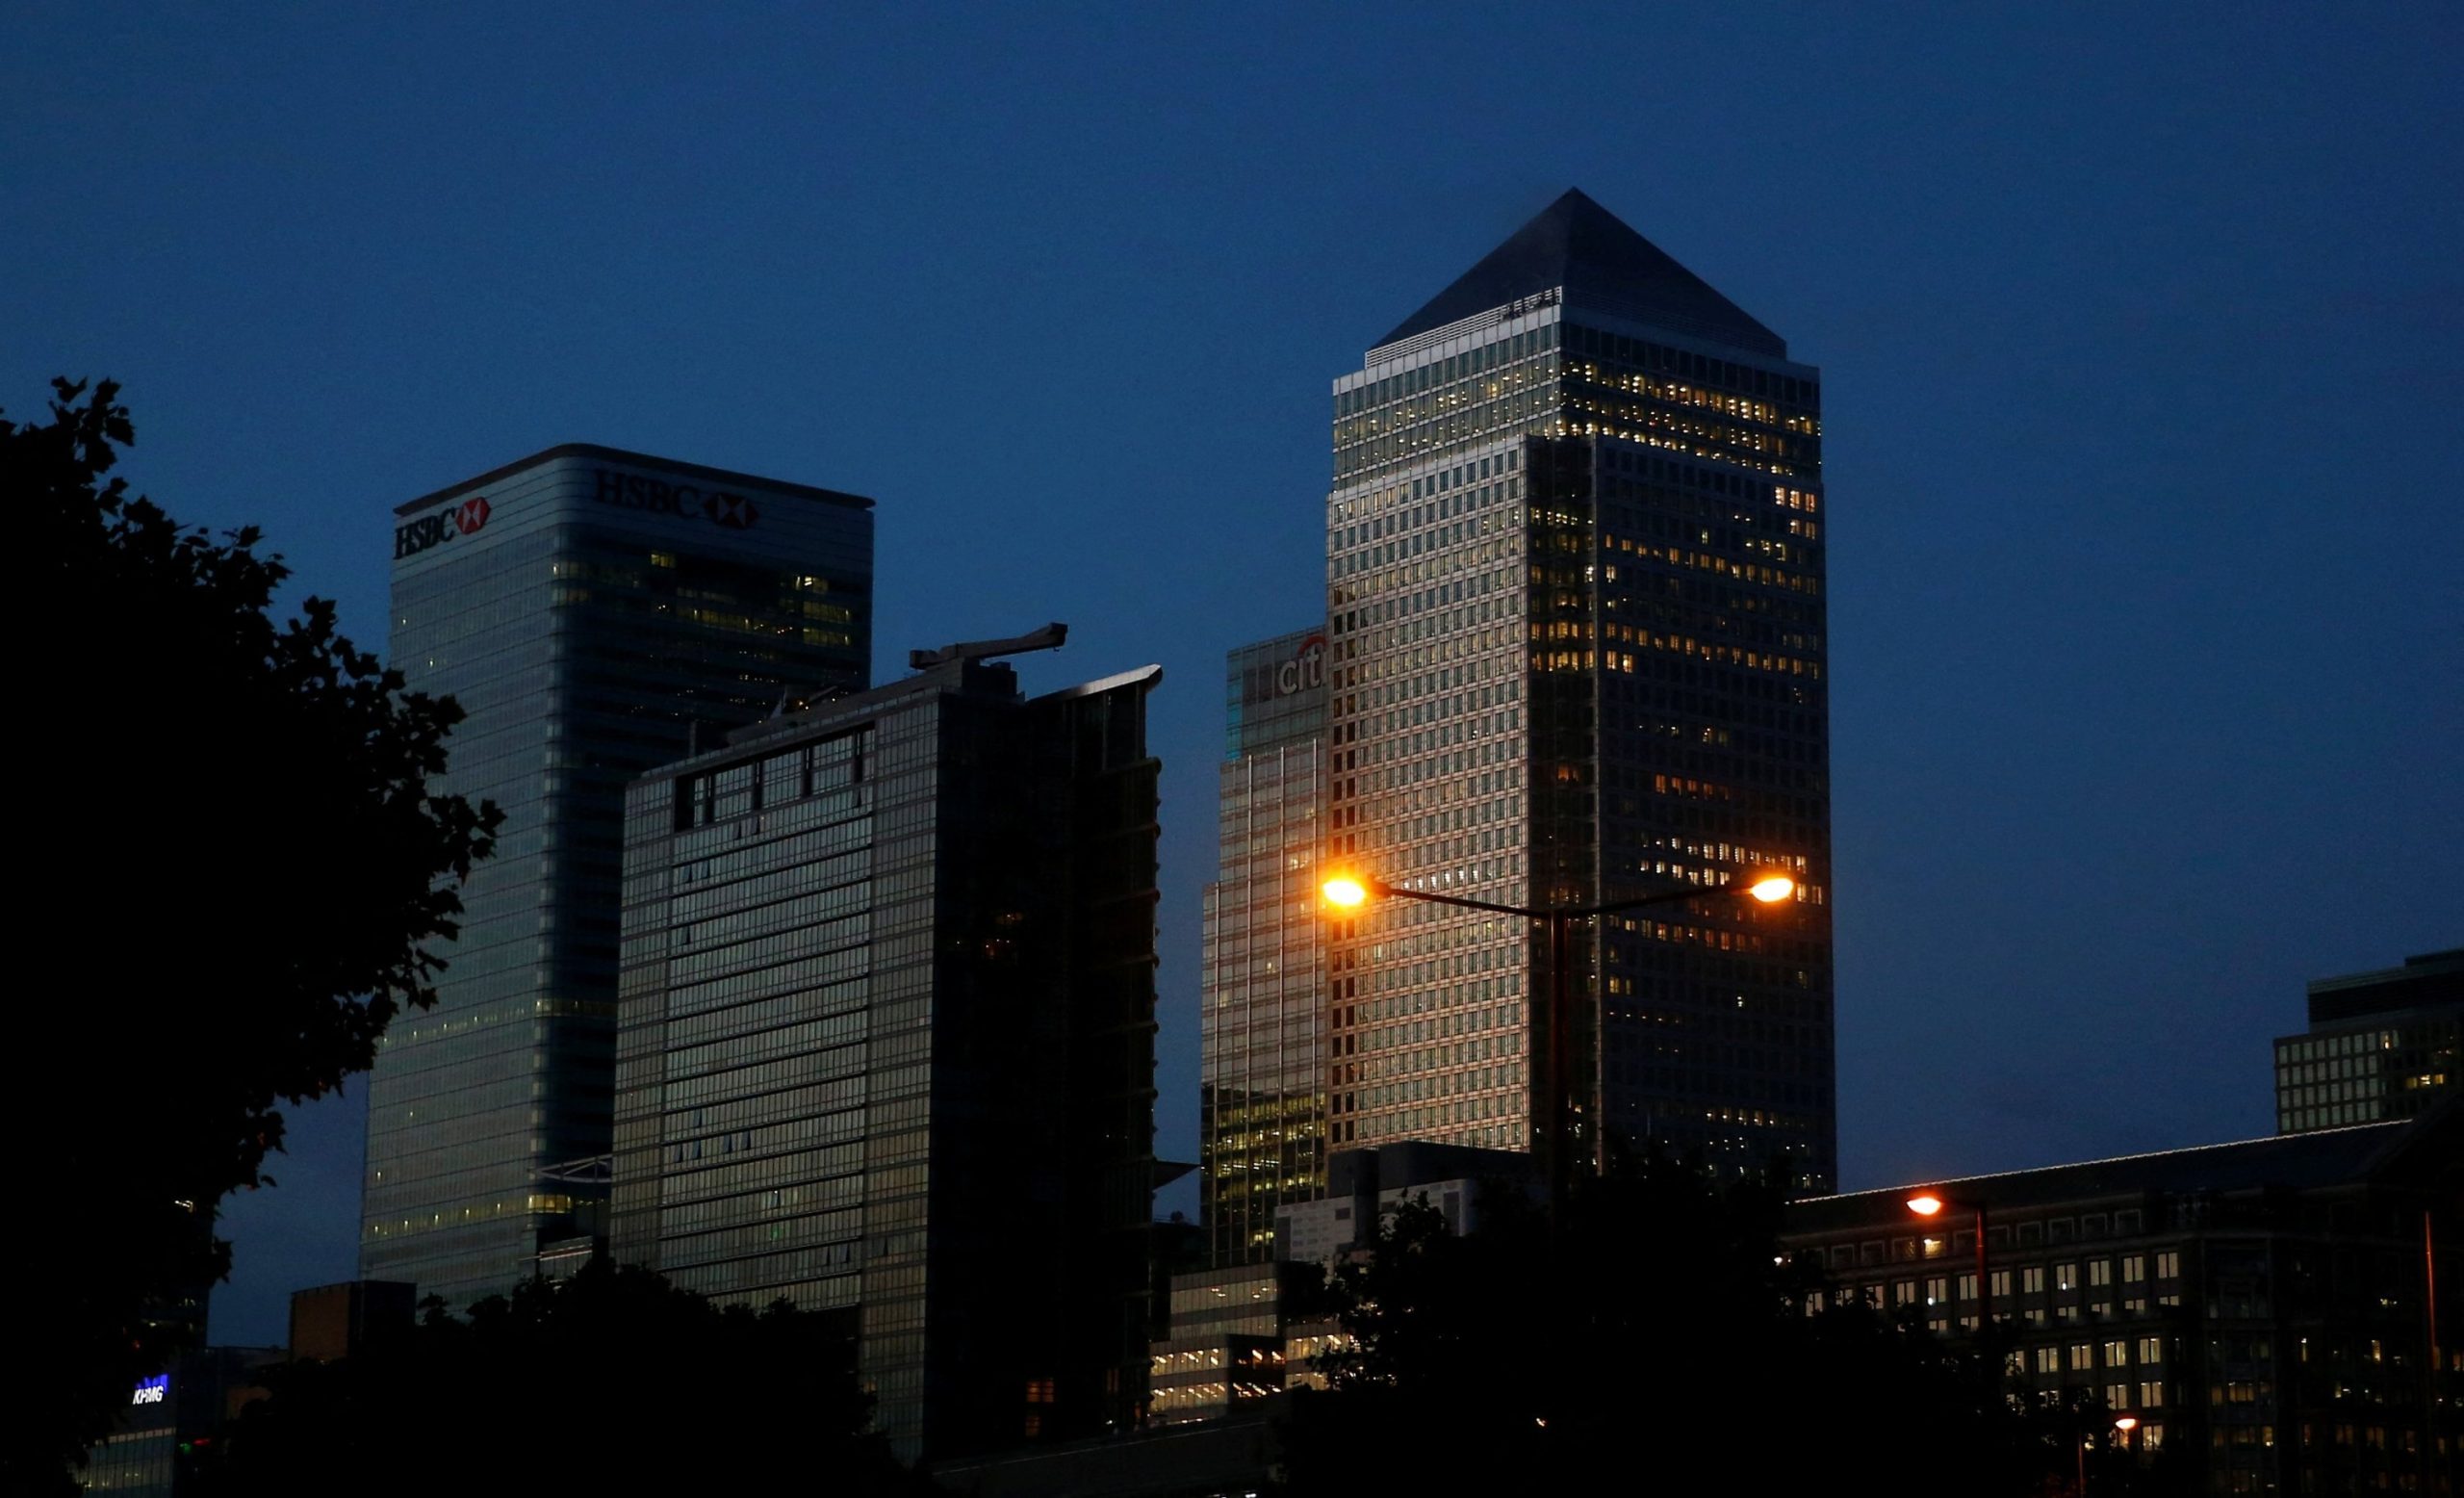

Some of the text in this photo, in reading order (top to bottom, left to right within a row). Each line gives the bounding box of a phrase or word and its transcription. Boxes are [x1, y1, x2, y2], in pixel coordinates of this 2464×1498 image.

[595, 469, 701, 519] HSBC
[394, 507, 455, 559] HSBC
[132, 1384, 164, 1405] KPMG
